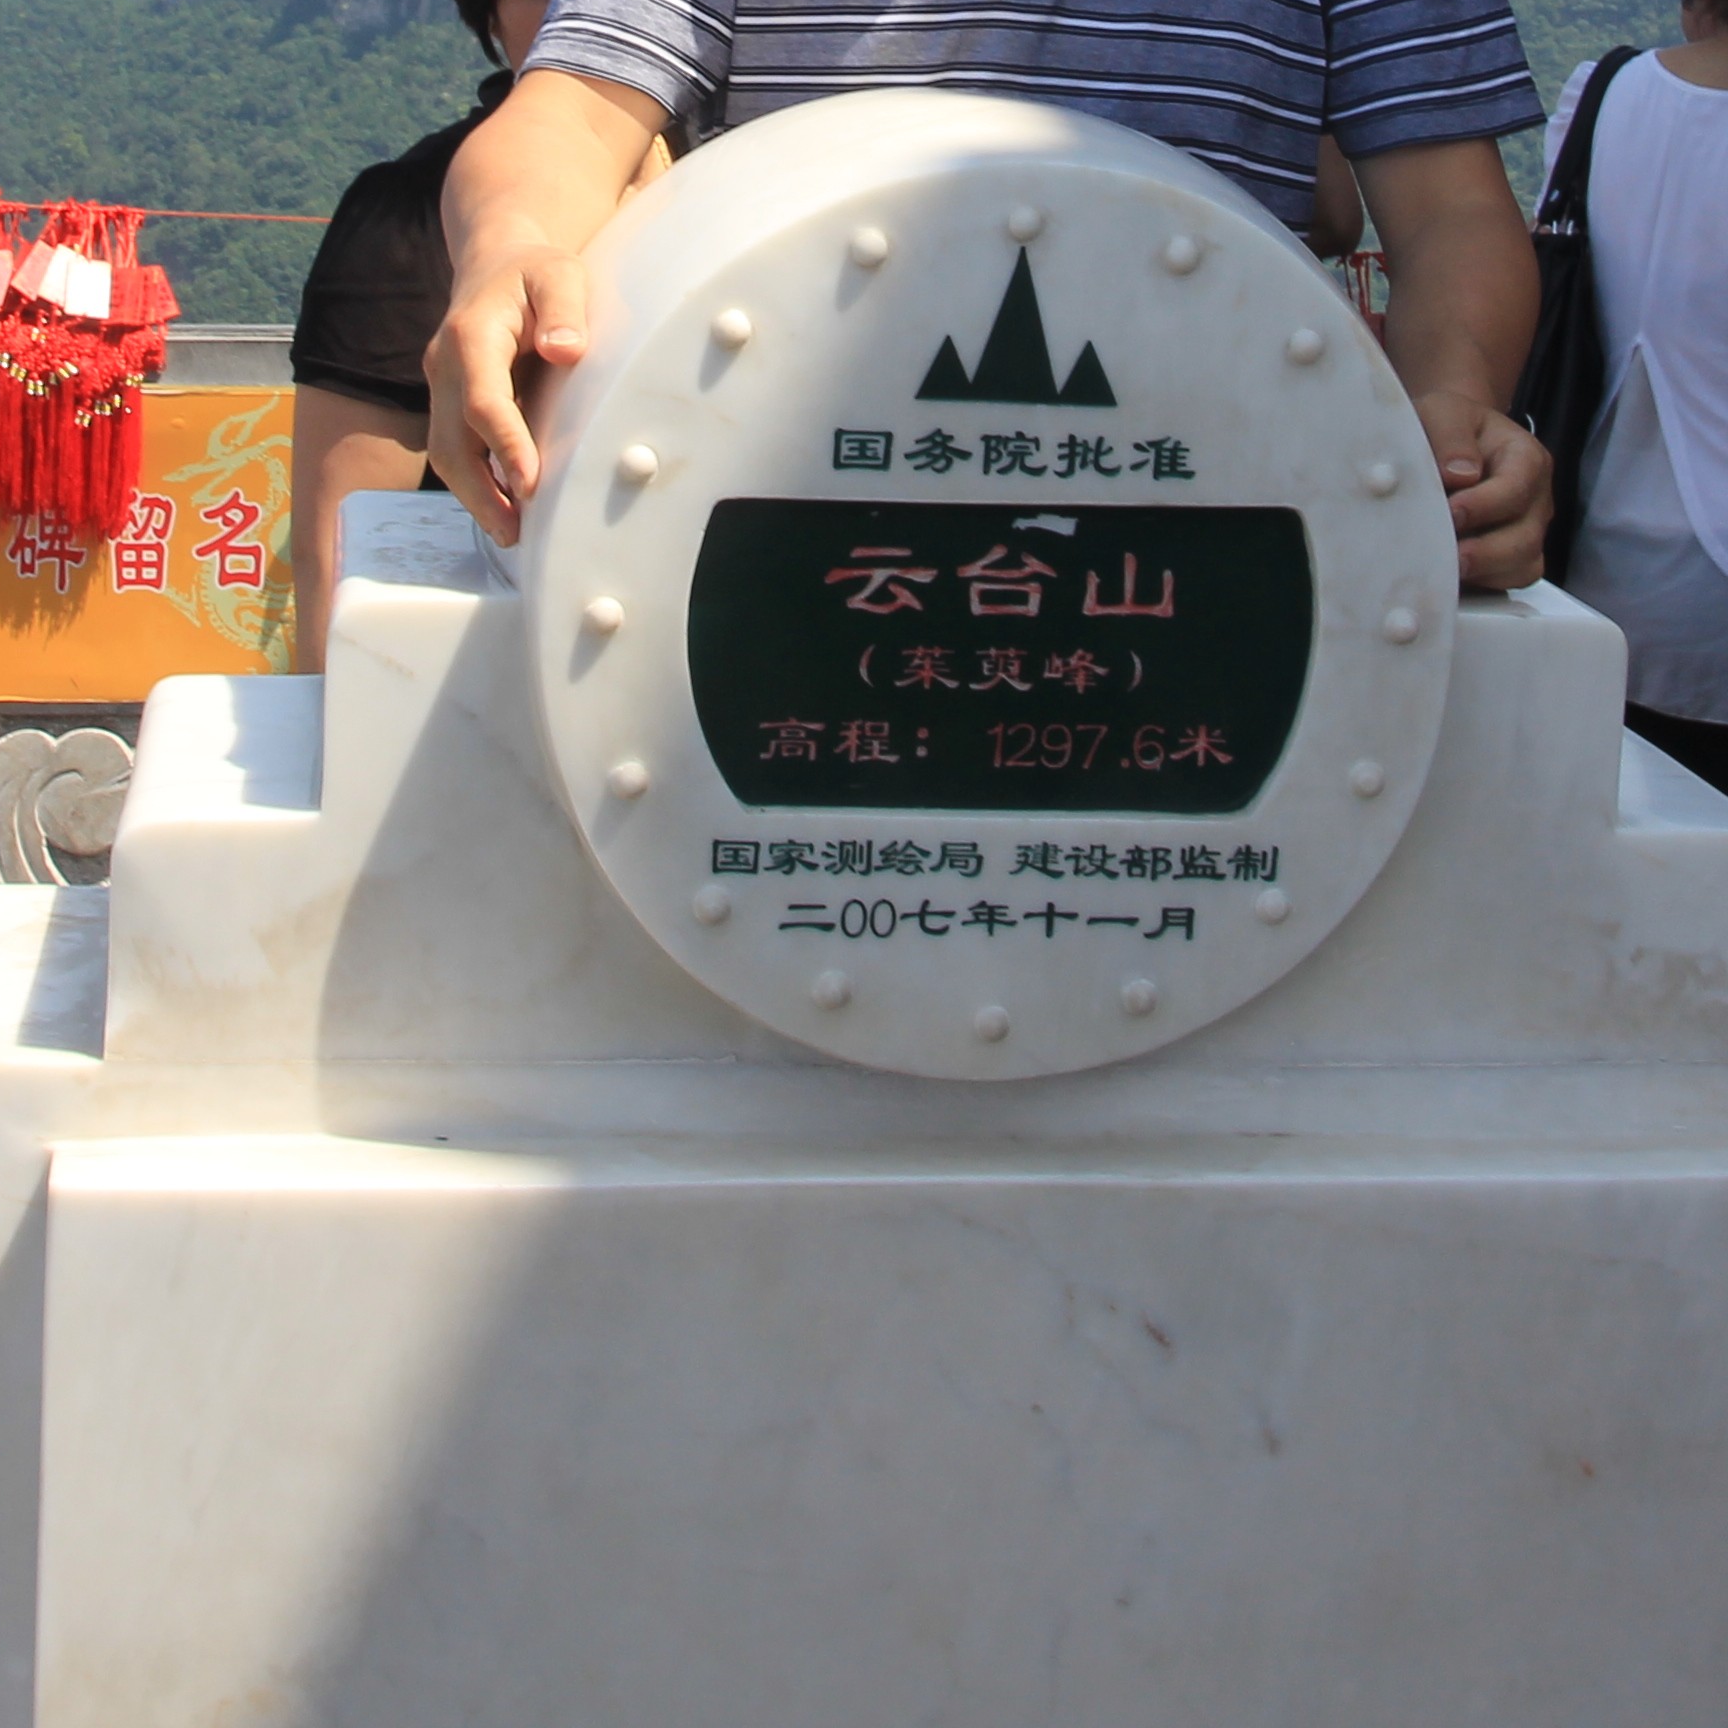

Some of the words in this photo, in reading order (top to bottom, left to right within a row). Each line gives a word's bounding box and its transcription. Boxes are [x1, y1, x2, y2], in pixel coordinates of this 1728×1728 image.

[832, 427, 1196, 481] 国务院批准
[823, 543, 1174, 618] 云台山
[986, 721, 1233, 771] 1297.6米
[710, 838, 985, 877] 国家测绘局
[1008, 842, 1280, 882] 建设部监制
